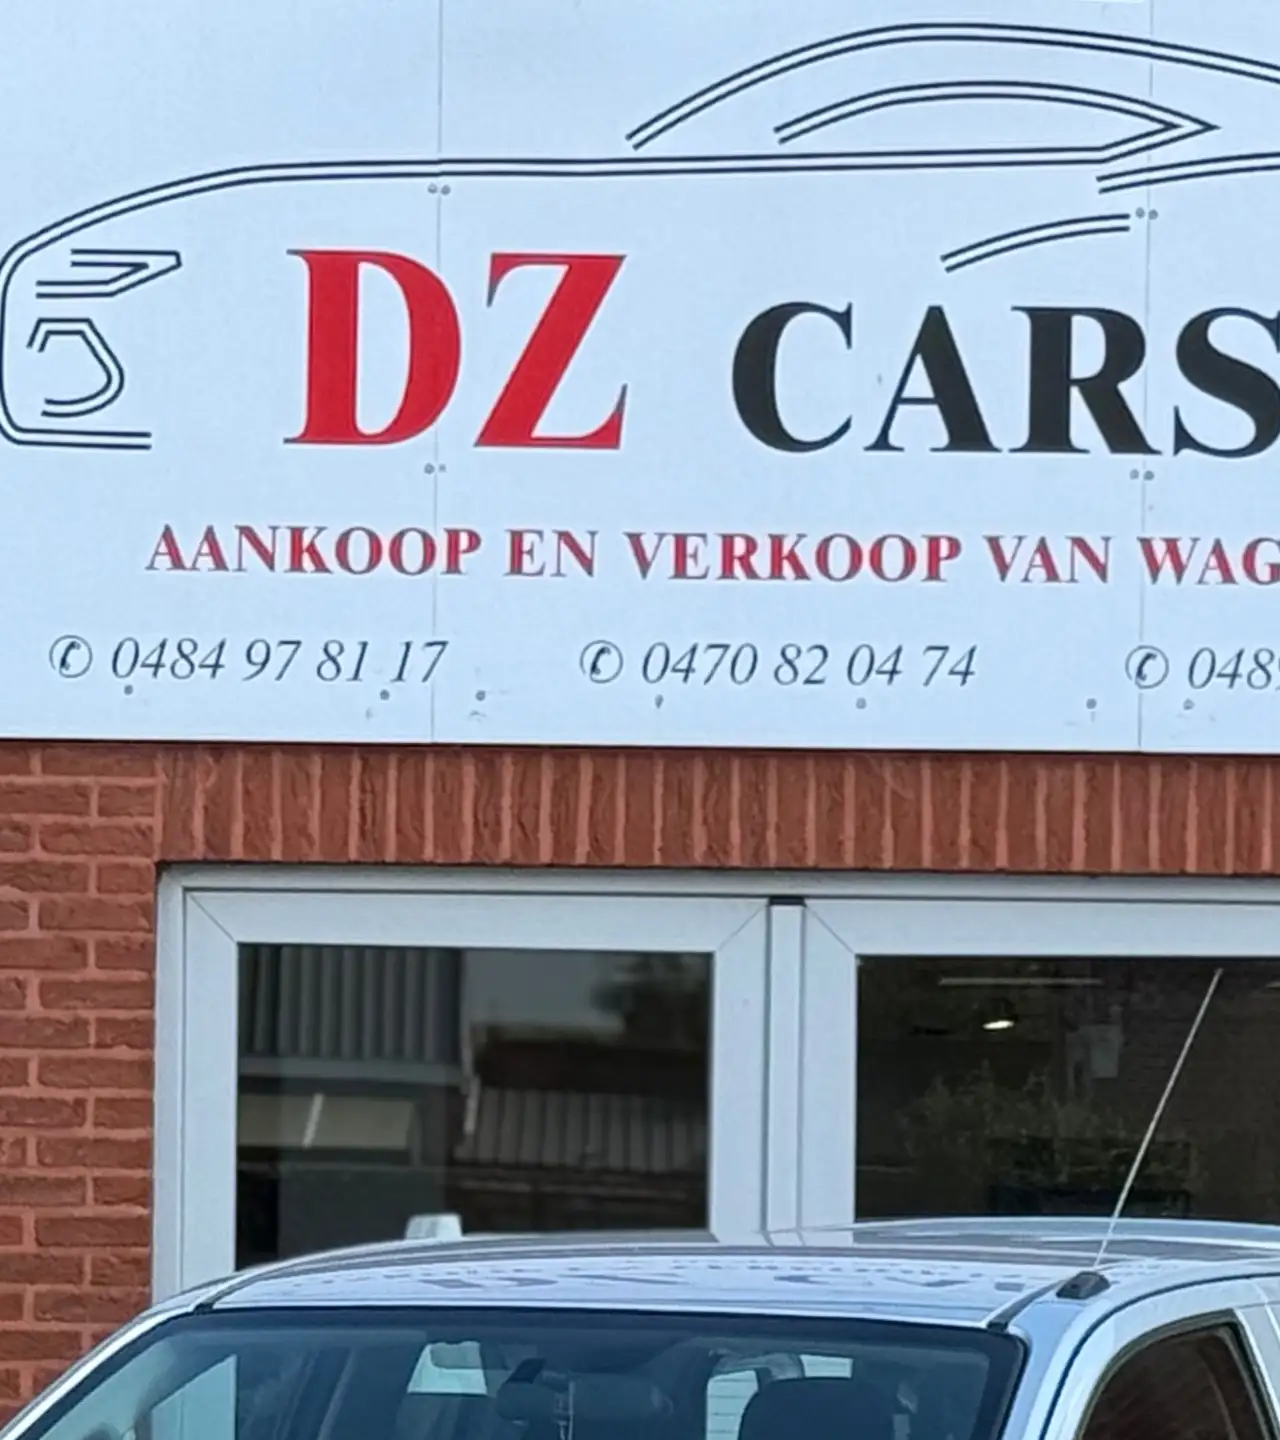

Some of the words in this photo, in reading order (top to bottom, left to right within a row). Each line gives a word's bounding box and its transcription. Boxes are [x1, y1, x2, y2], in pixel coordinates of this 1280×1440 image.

[283, 249, 628, 449] DZ
[145, 524, 482, 577] AANKOOP
[506, 529, 598, 577] EN
[624, 532, 962, 582] VERKOOP
[985, 535, 1112, 584] VAN
[111, 637, 226, 680] 0484
[244, 639, 303, 681] 97
[316, 639, 369, 682] 81
[389, 640, 449, 683] 17
[642, 642, 759, 685] 0470
[773, 643, 829, 686] 82
[846, 644, 903, 686] 04
[923, 645, 978, 687] 74
